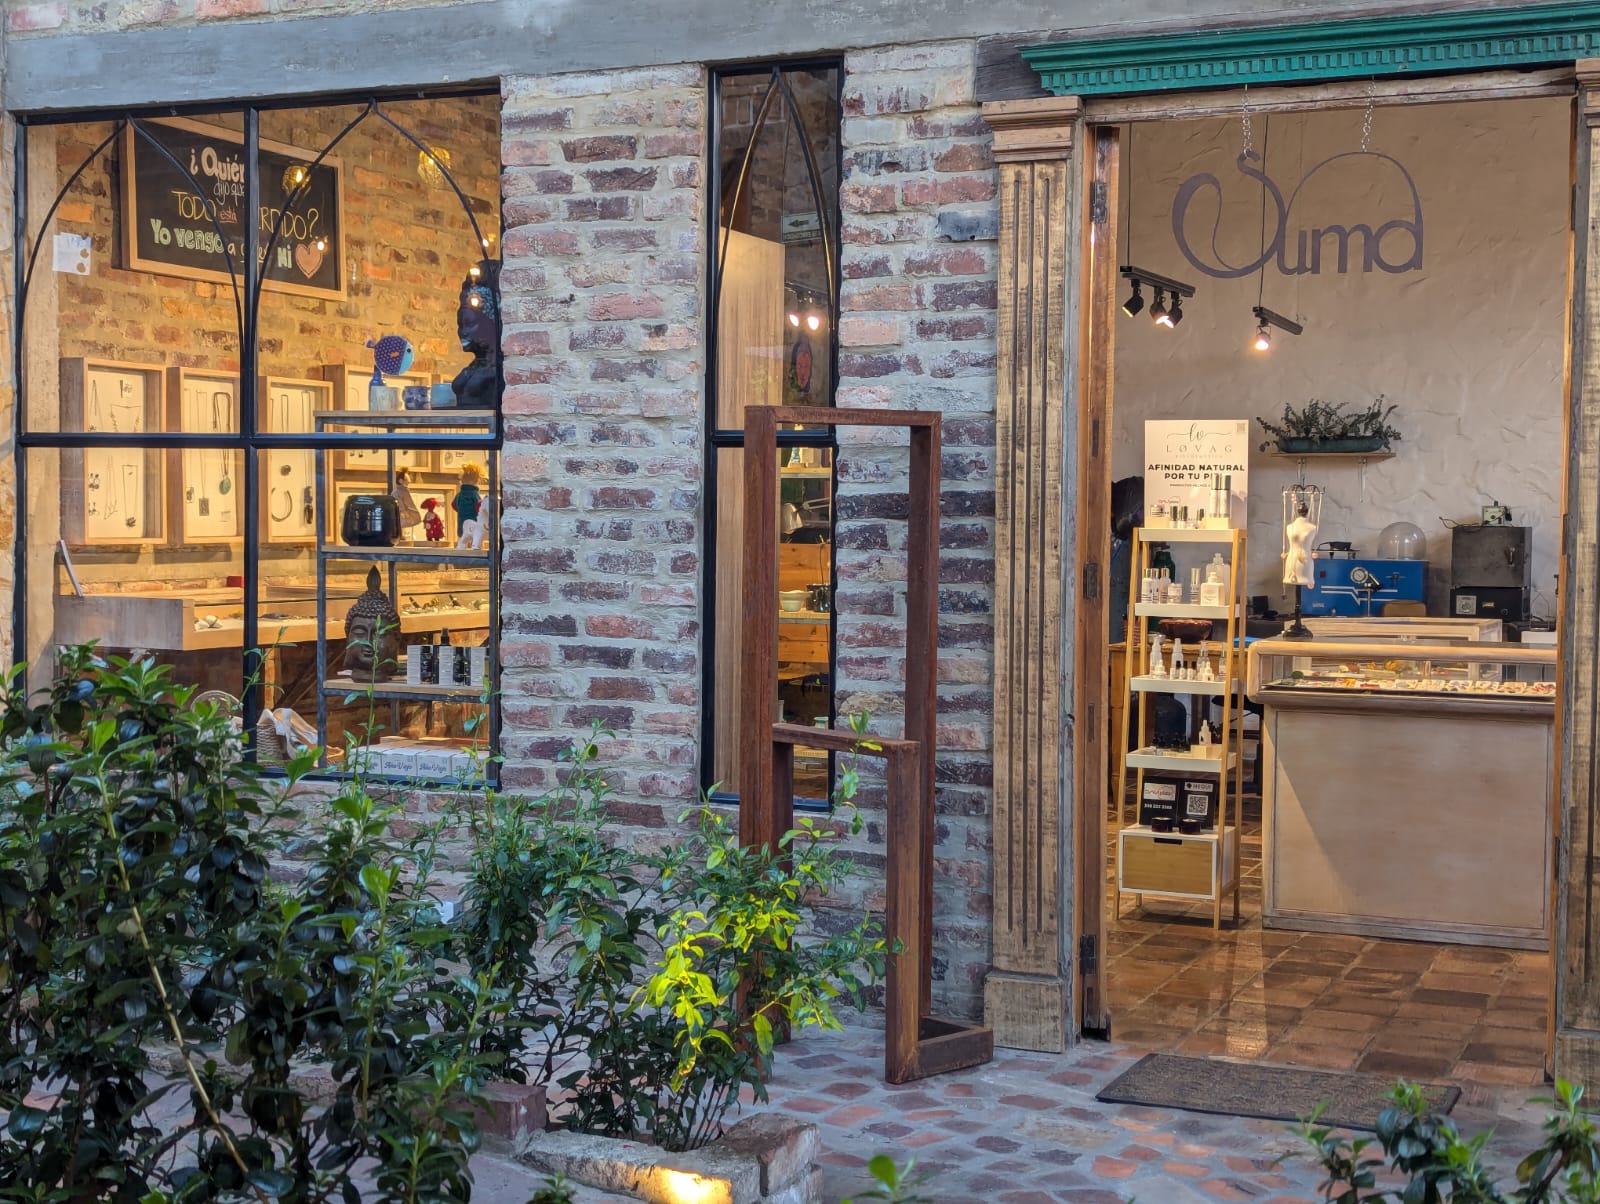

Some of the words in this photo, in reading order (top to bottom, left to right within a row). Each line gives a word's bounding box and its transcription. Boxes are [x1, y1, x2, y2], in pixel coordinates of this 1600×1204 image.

[171, 190, 217, 222] TODO
[243, 202, 319, 240] RDIDO?
[150, 218, 172, 245] Yo
[173, 228, 225, 254] vengo
[228, 242, 236, 256] a
[1164, 472, 1185, 480] POR
[1188, 472, 1200, 480] TU
